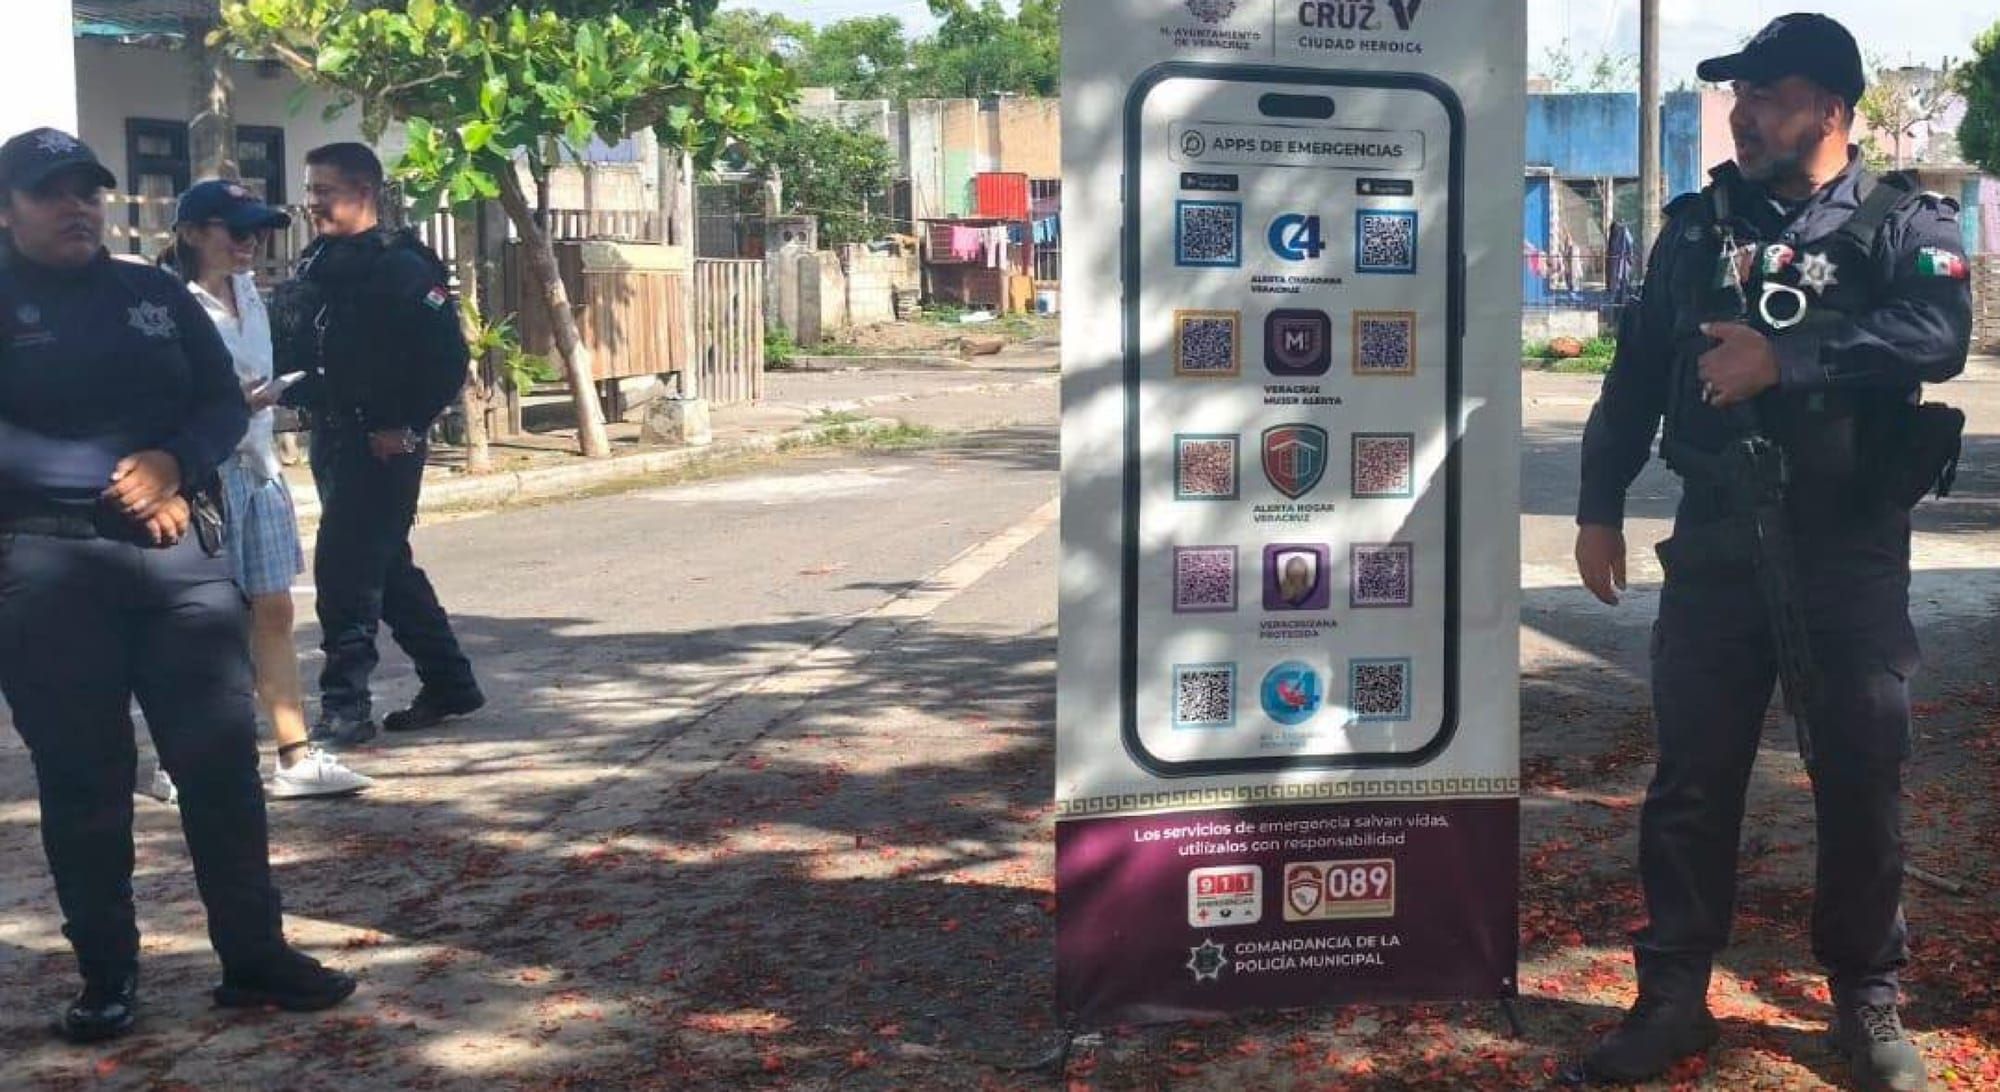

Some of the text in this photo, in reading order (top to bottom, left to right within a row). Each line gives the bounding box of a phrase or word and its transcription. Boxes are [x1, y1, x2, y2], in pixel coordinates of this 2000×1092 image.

[1299, 1, 1376, 30] CRUZ
[1299, 36, 1354, 50] CIUDAD
[1212, 137, 1403, 157] APPS DE EMERGENCIAS
[1263, 385, 1320, 394] VERACRUZ
[1134, 829, 1161, 842] Los
[1163, 821, 1232, 839] servicios
[1235, 820, 1255, 833] de
[1259, 815, 1350, 833] emergencia
[1353, 813, 1402, 828] salvan
[1251, 840, 1280, 851] con
[1284, 831, 1406, 851] responsabilidad
[1328, 866, 1388, 898] 089
[1235, 934, 1400, 955] COMANDANCIA DE LA
[1235, 952, 1385, 973] POLICÍA MUNICIPAL
